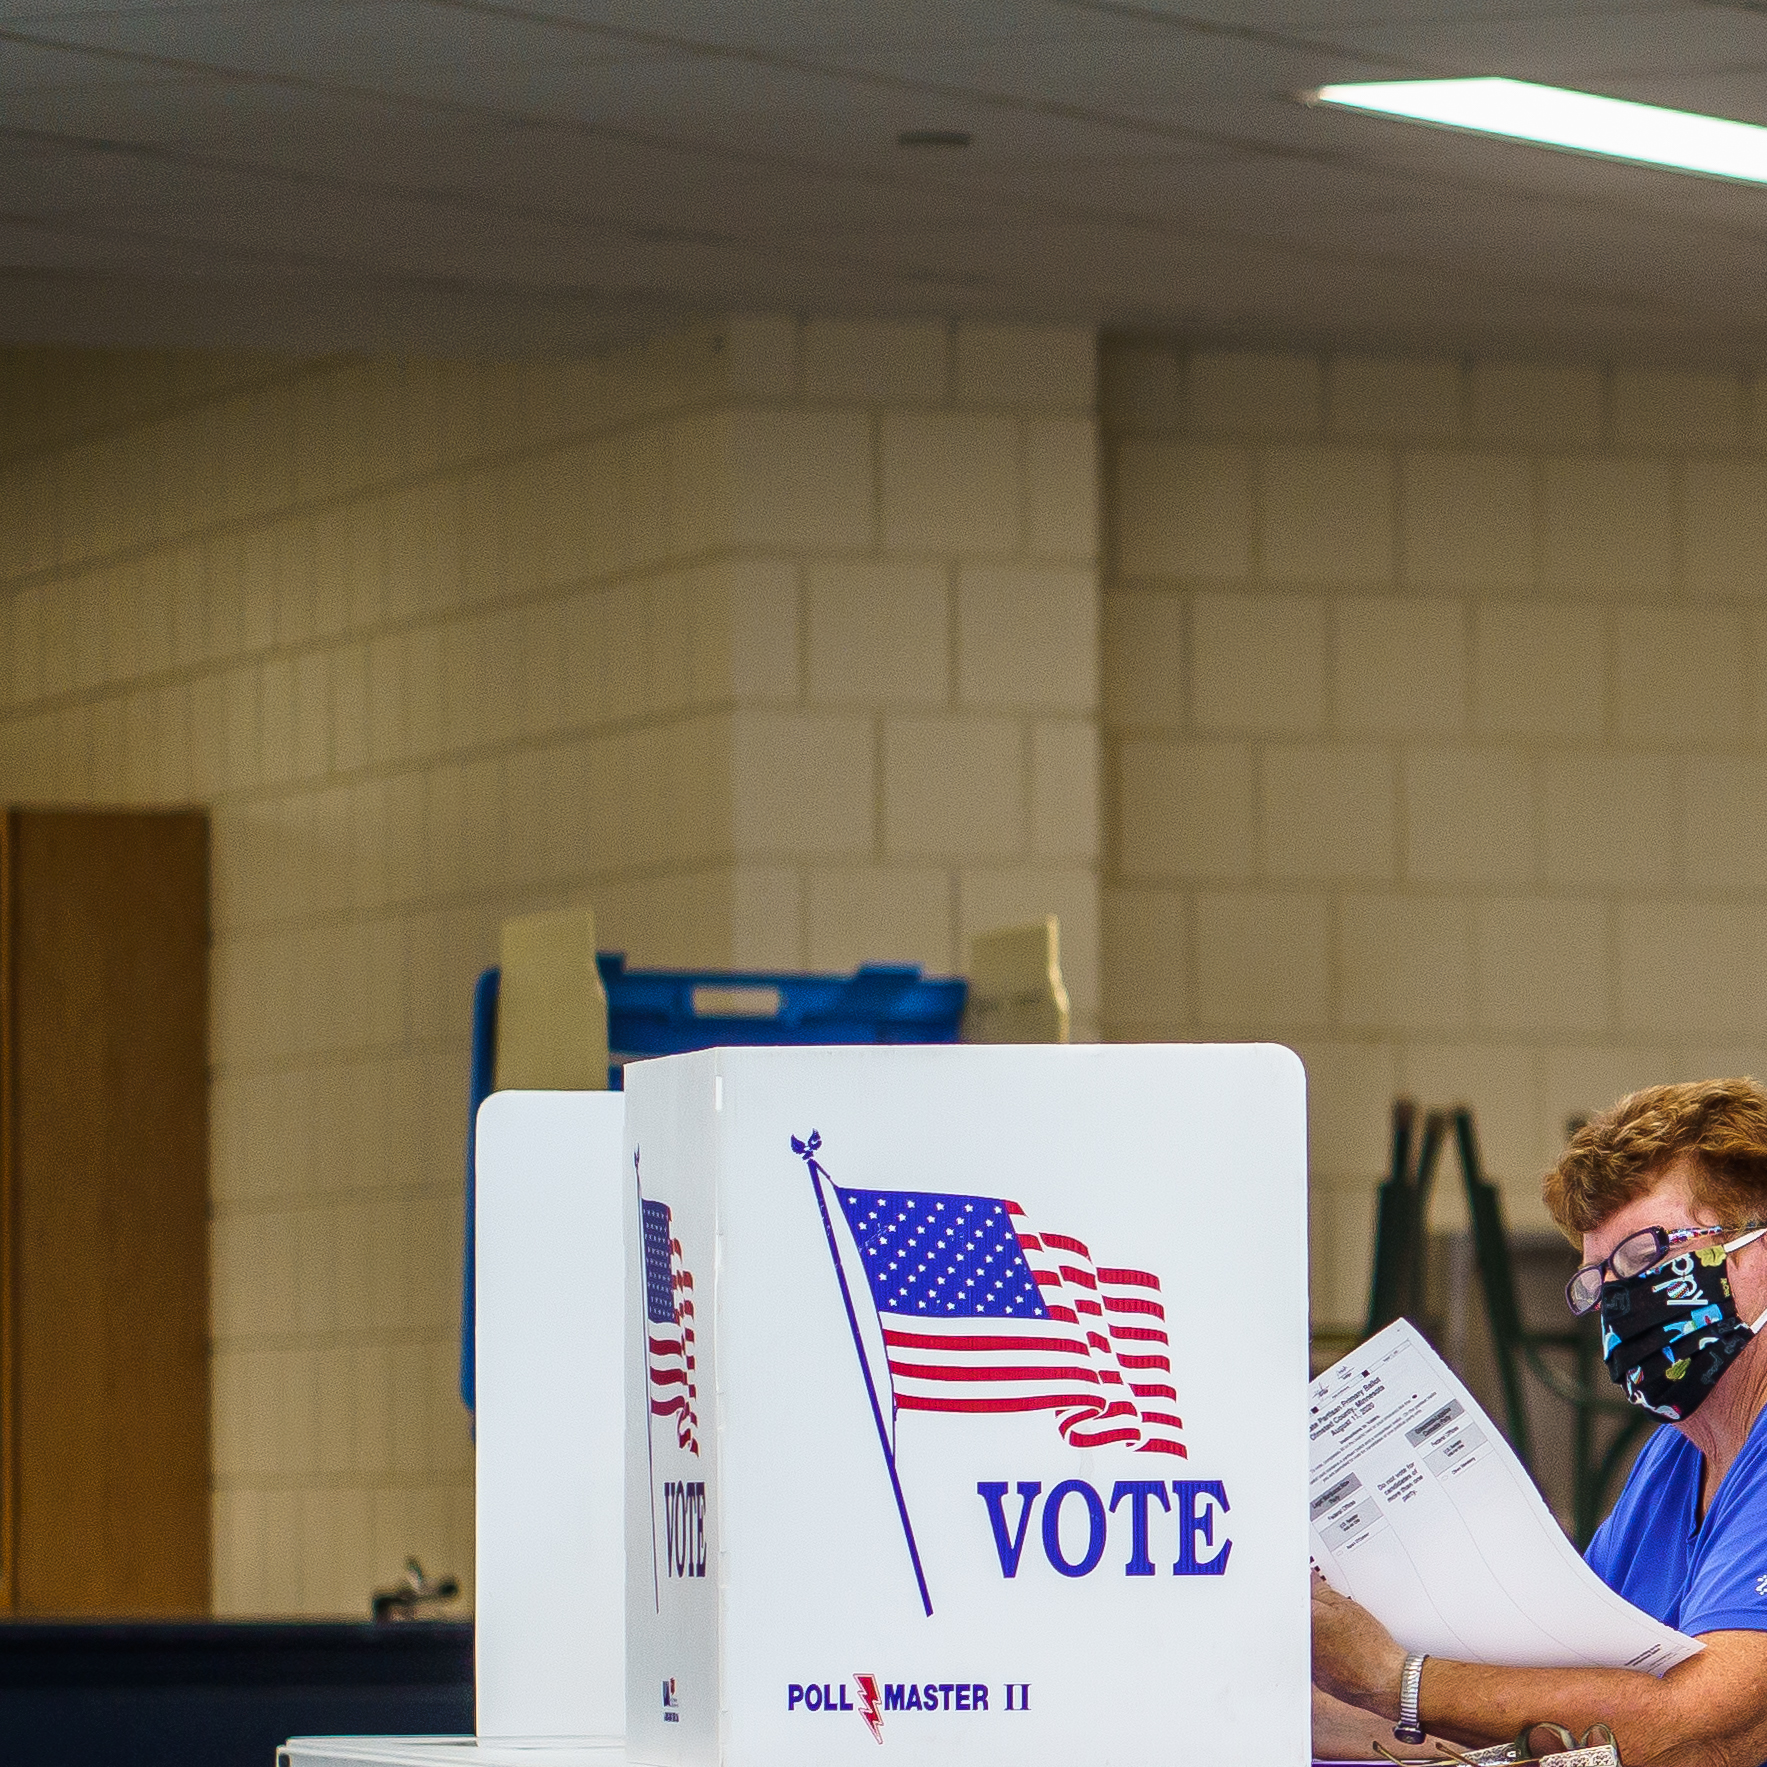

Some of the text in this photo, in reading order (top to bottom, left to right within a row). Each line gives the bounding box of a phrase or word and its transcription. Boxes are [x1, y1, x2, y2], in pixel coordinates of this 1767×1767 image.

[1385, 1475, 1396, 1485] not
[1395, 1468, 1407, 1478] vote
[1406, 1462, 1415, 1470] for
[664, 1480, 707, 1578] VOTE
[977, 1480, 1234, 1578] VOTE
[788, 1683, 1032, 1711] POLL MASTER II
